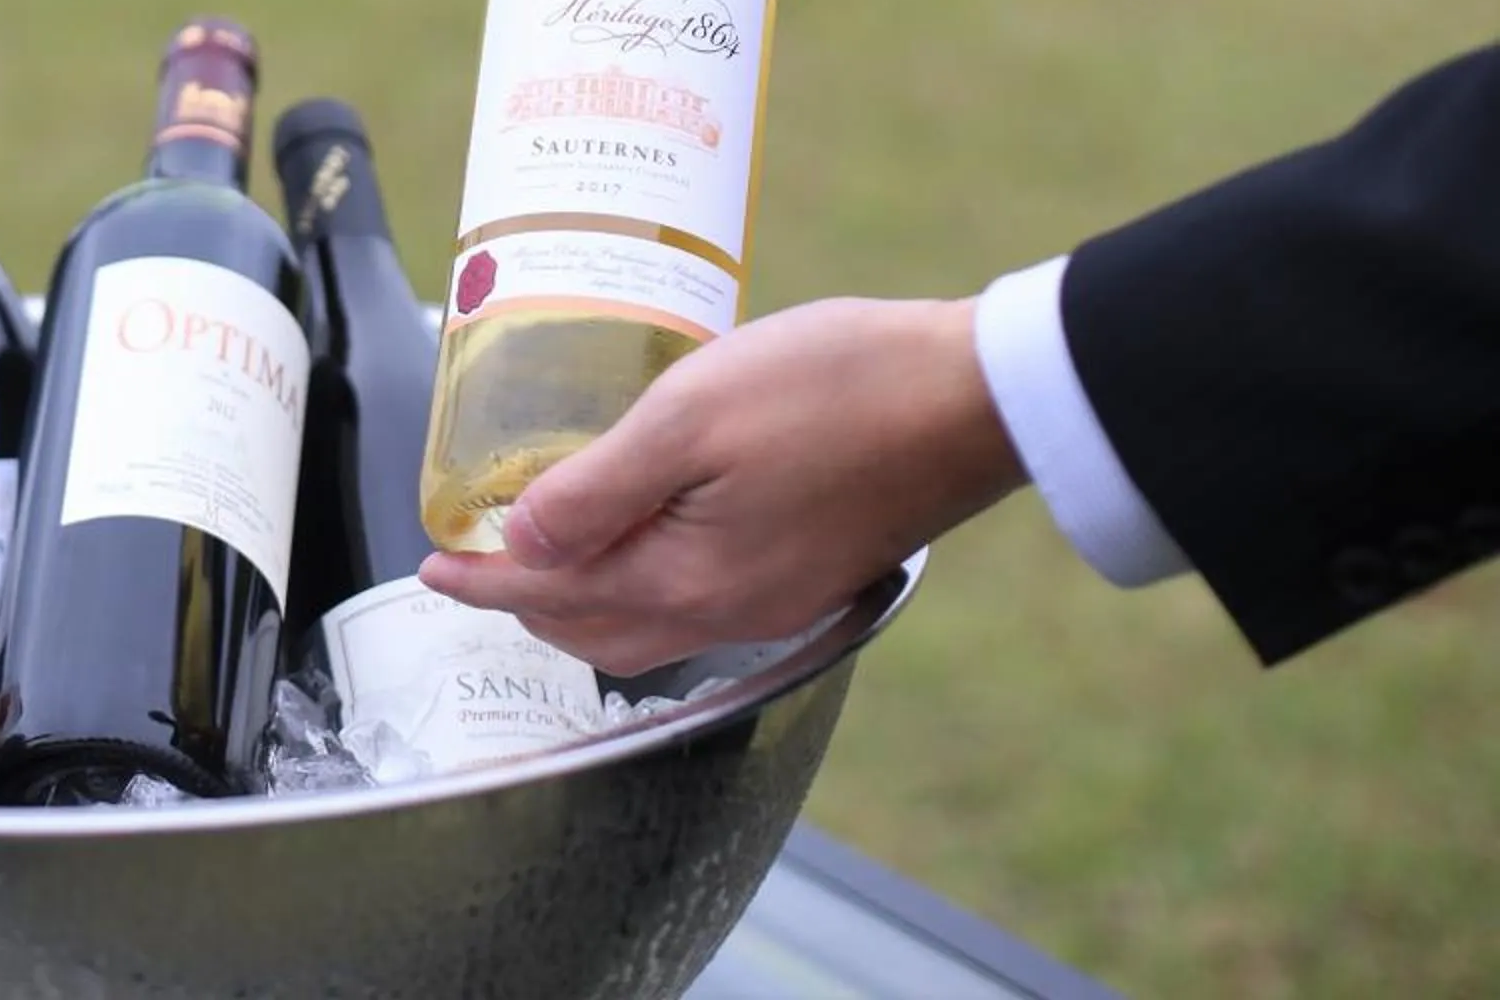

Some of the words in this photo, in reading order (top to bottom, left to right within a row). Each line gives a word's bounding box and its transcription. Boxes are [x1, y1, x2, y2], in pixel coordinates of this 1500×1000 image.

[679, 10, 741, 60] 1864
[531, 136, 678, 167] SAUTERNES
[117, 298, 300, 430] OPTIMA
[457, 708, 521, 728] Premier
[526, 709, 554, 726] Cru
